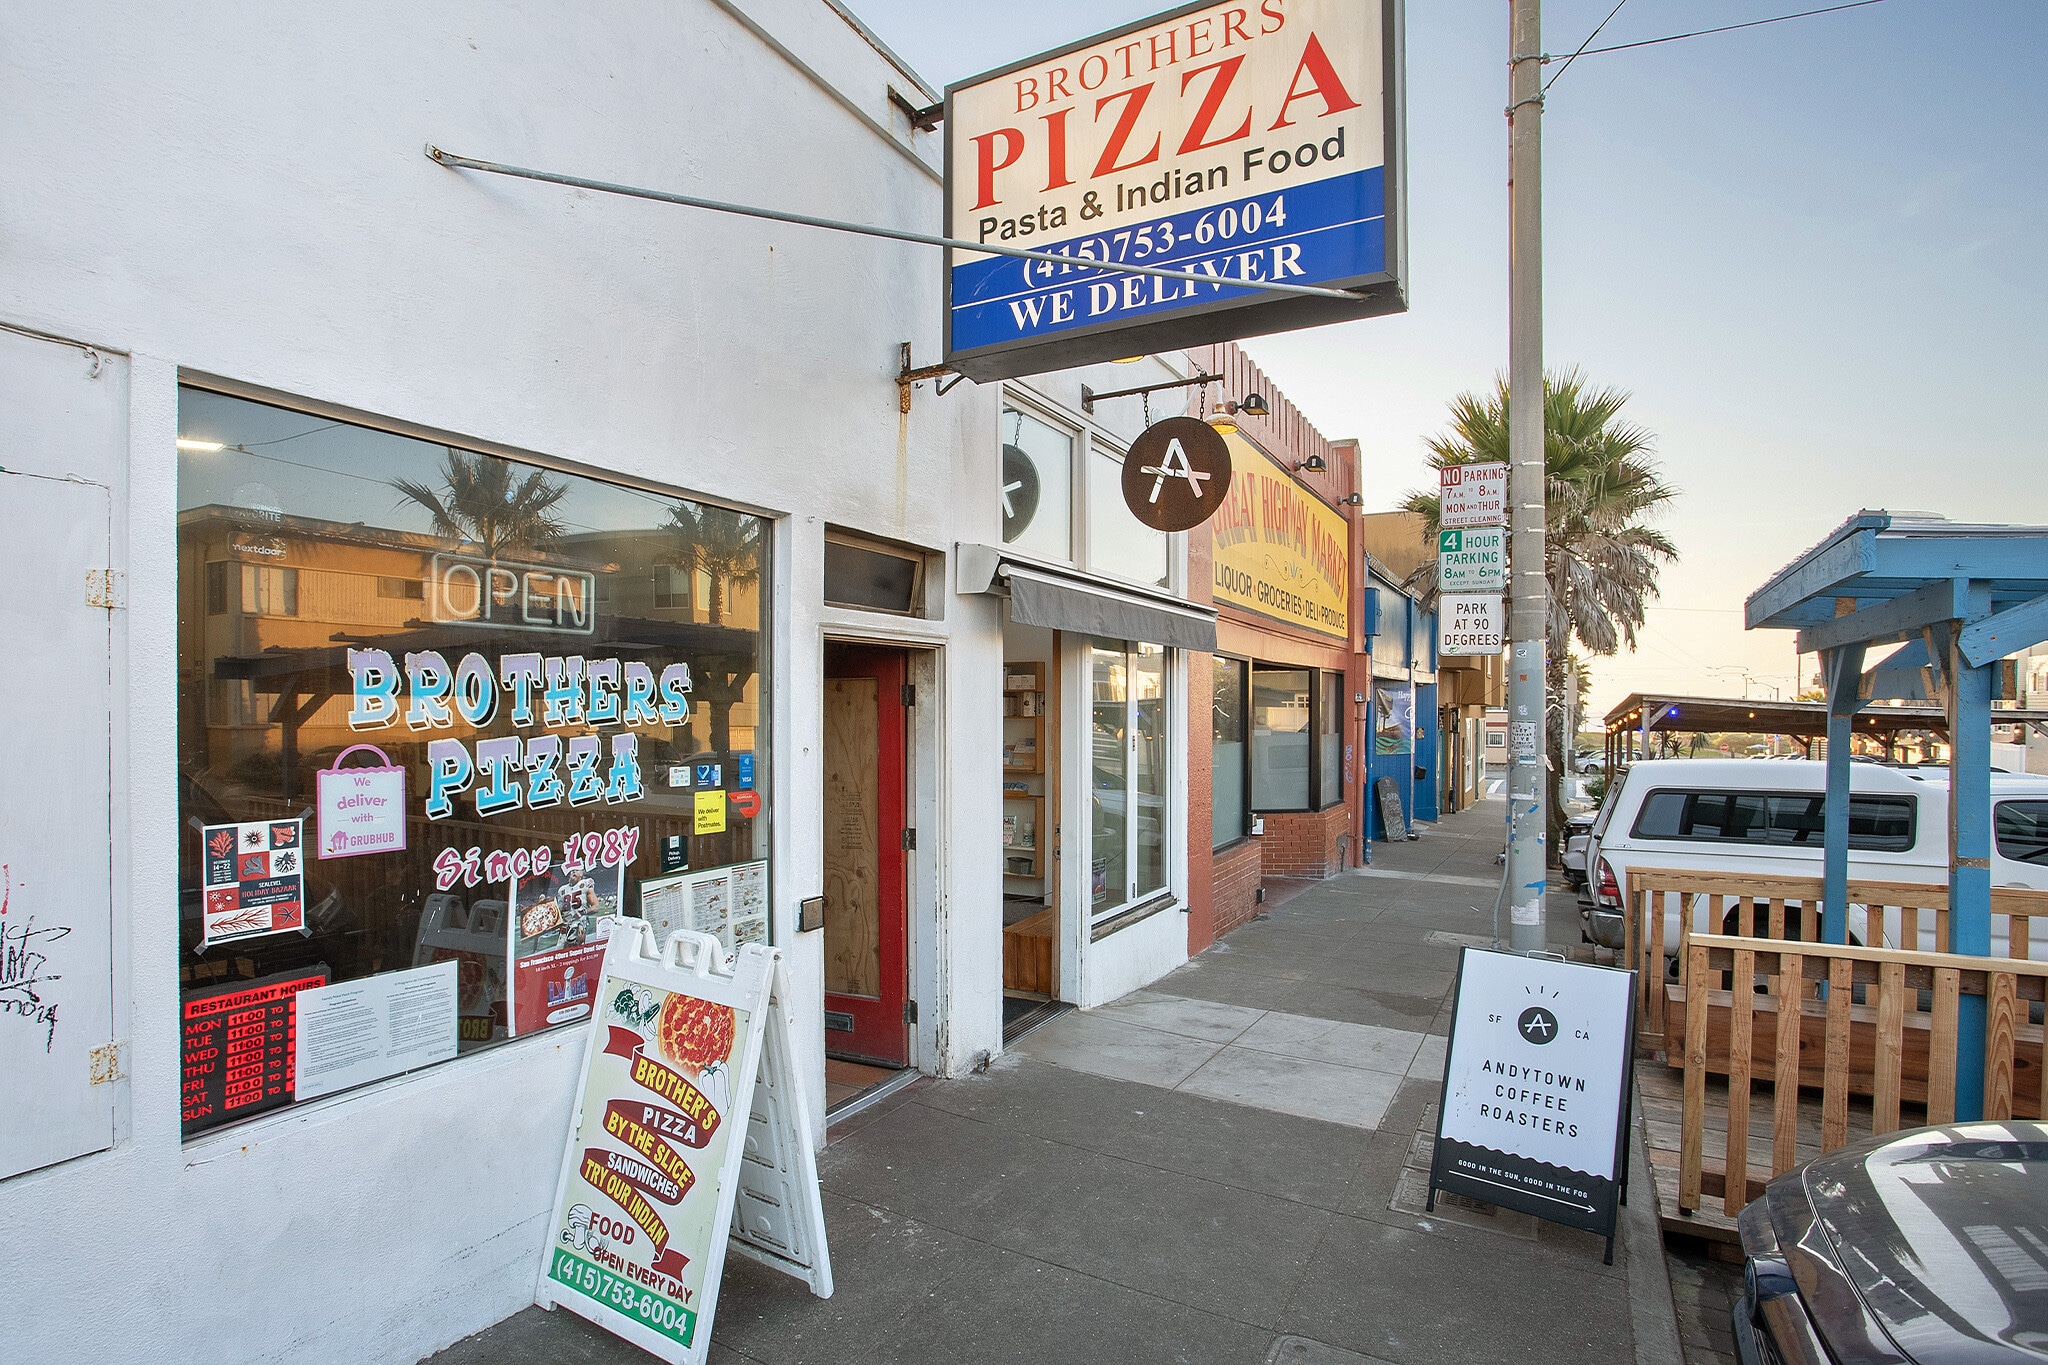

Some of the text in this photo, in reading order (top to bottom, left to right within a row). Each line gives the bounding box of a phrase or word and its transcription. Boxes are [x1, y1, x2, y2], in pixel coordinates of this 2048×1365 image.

[1014, 0, 1286, 114] BROTHERS
[968, 32, 1362, 212] PIZZA
[979, 126, 1346, 244] Pasta & Indian Food
[1022, 195, 1287, 289] (415)753-6004
[1008, 241, 1306, 332] WE DELIVER
[1140, 438, 1211, 504] A
[1443, 467, 1504, 486] NO PARKING
[1446, 501, 1466, 513] MON
[1478, 500, 1500, 512] THUR
[1470, 514, 1502, 523] CLEANING
[232, 544, 281, 555] nextdoor
[1261, 475, 1309, 550] HIGHWAY
[1311, 512, 1347, 598] MARKET
[1443, 533, 1499, 550] 4 HOUR
[1444, 567, 1465, 579] 8AM
[1478, 566, 1501, 578] 6PM
[1446, 551, 1498, 565] PARKING
[443, 565, 586, 627] OPEN
[1214, 560, 1345, 630] LIQUOR GROCERIES DELI PRODUCE
[1456, 603, 1487, 614] PARK
[1444, 634, 1499, 647] DEGREES
[1454, 618, 1489, 630] AT 90
[347, 648, 693, 732] BROTHERS
[354, 777, 371, 786] We
[426, 732, 644, 821] PIZZA
[337, 793, 387, 810] deliver
[351, 813, 373, 822] with
[350, 832, 395, 846] GRUBHUB
[433, 845, 552, 891] Since
[561, 825, 640, 875] 1987
[242, 884, 297, 898] HOLIDAY BAZAAR
[531, 956, 554, 966] Francisco
[555, 951, 569, 960] 49ers
[569, 948, 583, 957] Super
[191, 980, 320, 1015] RESTAURANT HOURS
[185, 1006, 284, 1036] MON 11:00 TO
[185, 1020, 283, 1049] TUE 11:00 TO
[1488, 1014, 1502, 1024] SF
[1575, 1030, 1590, 1041] CA
[184, 1046, 282, 1078] THU 11:00 TO
[185, 1033, 283, 1064] WED 11:00 TO
[182, 1073, 281, 1108] SAT 11:00 TO
[183, 1060, 282, 1093] FRI 11:00 TO
[1482, 1059, 1586, 1092] ANDYTOWN
[182, 1087, 280, 1122] SUN 11:00 TO
[635, 1057, 717, 1132] BROTHER'S
[1495, 1084, 1568, 1112] COFFEE
[643, 1106, 697, 1145] PIZZA
[1480, 1104, 1578, 1138] ROASTERS
[607, 1110, 691, 1189] BY THE SLICE
[607, 1152, 680, 1200] SANDWICHES
[1458, 1159, 1588, 1199] GOOD IN THE SUN, GOOD IN THE FOG
[585, 1158, 667, 1247] TRY OUR INDIAN
[588, 1211, 636, 1246] FOOD
[592, 1246, 693, 1306] OPEN EVERY DAY
[556, 1253, 688, 1337] (415)753-6004
